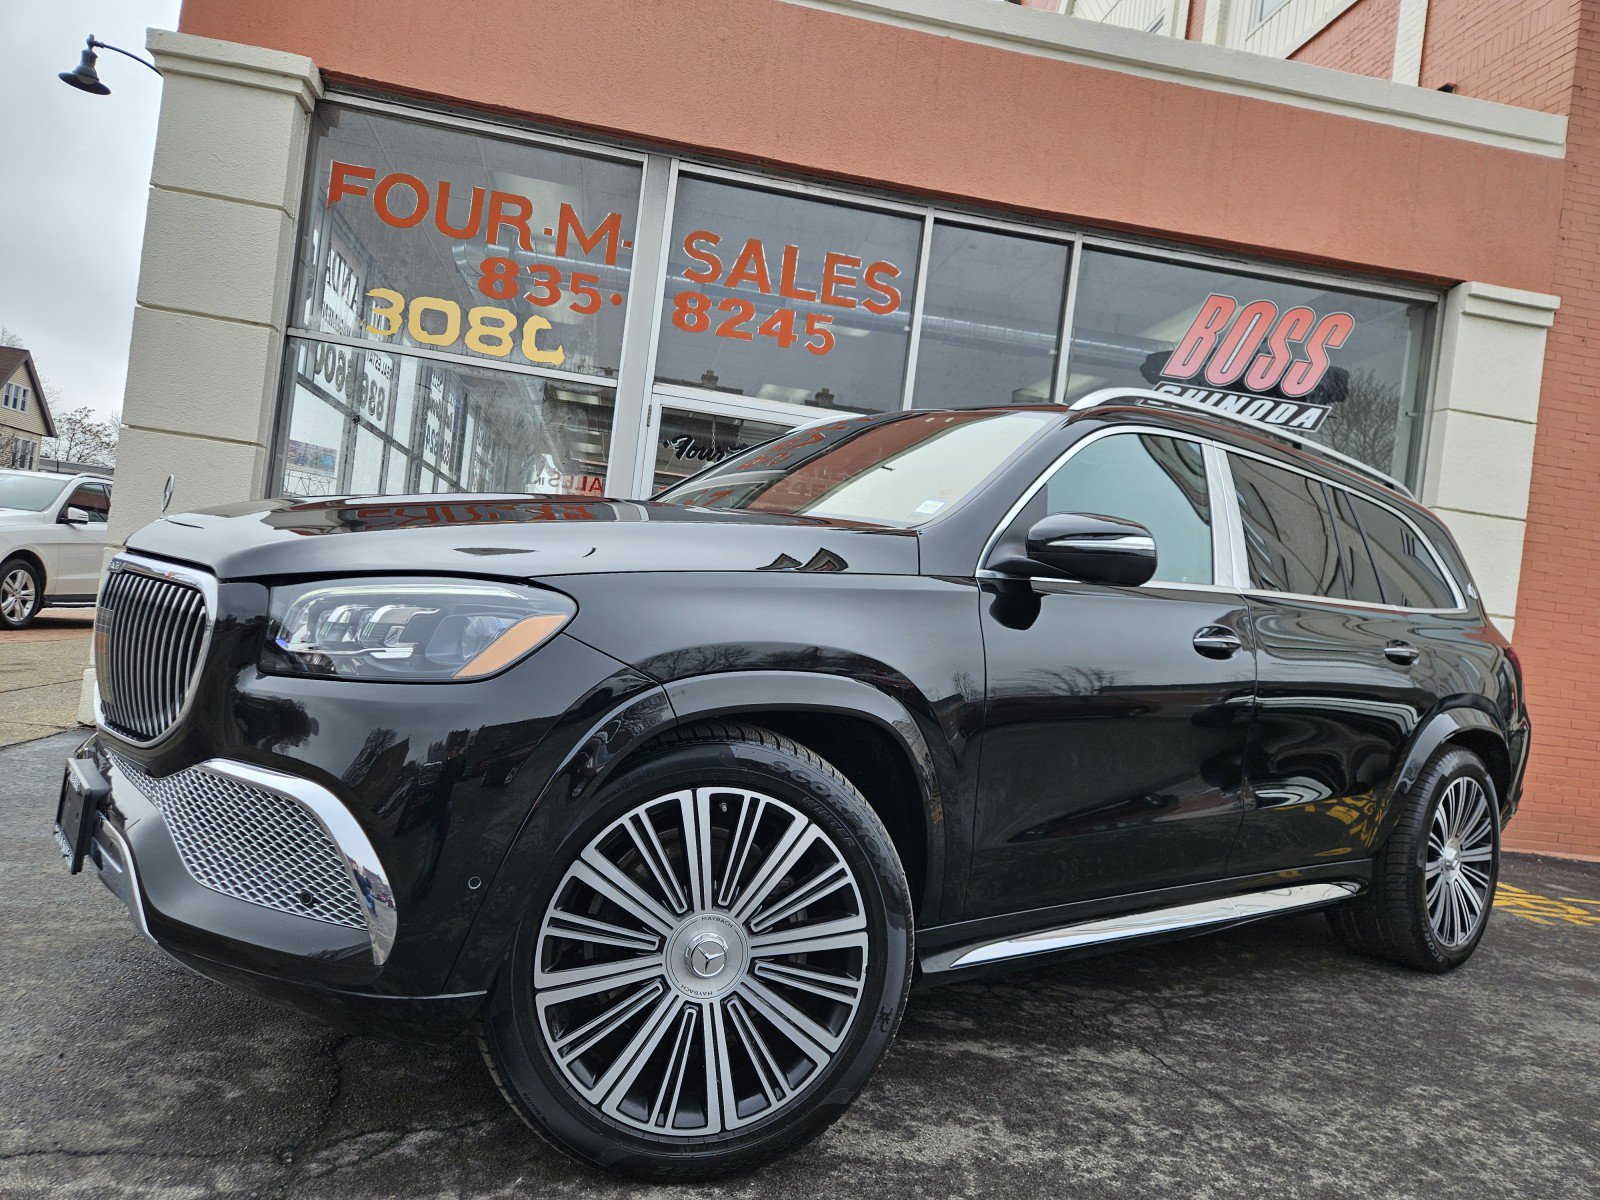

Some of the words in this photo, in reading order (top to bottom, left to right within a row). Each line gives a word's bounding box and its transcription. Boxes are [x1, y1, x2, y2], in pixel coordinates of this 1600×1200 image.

[682, 229, 902, 316] SALES
[672, 290, 836, 356] 8245
[1160, 293, 1356, 397] BOSS
[701, 916, 733, 929] MAYBACH
